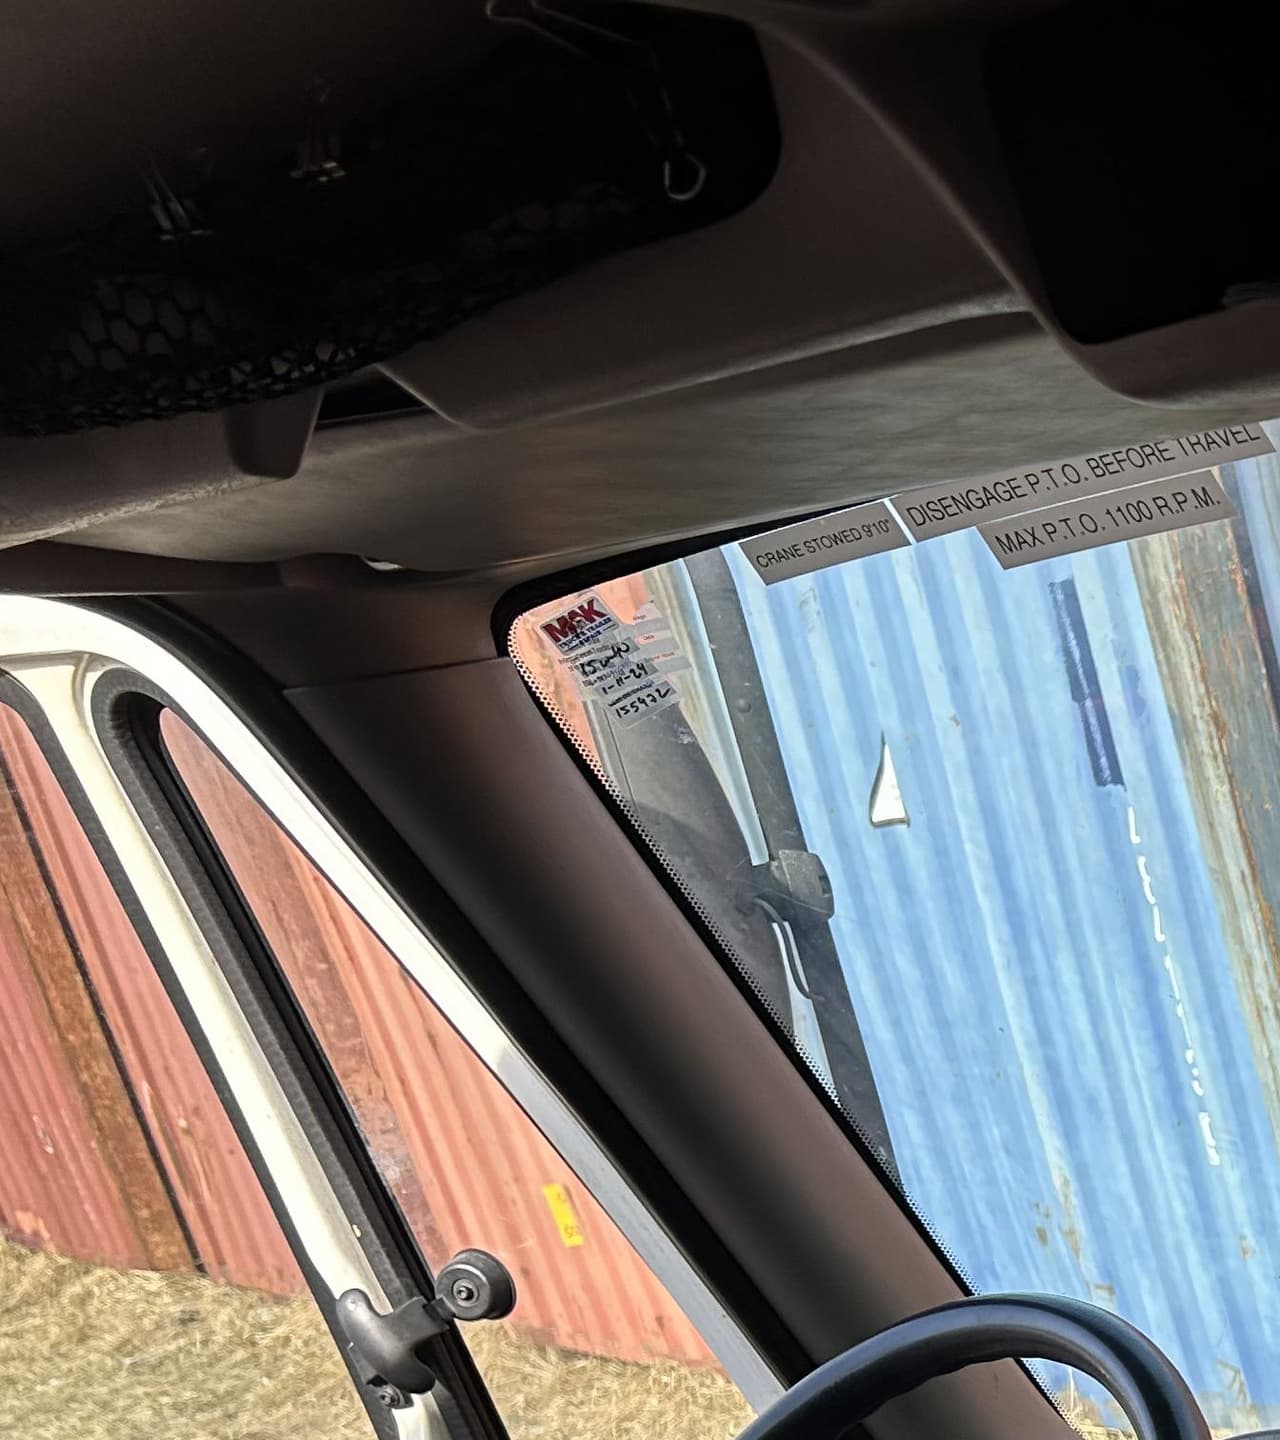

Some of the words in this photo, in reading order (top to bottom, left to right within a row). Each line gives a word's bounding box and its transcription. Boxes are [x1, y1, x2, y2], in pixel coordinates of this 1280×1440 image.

[906, 477, 1027, 527] DISENGAGE
[1025, 463, 1089, 494] P.T.O.
[1086, 440, 1175, 478] BEFORE
[756, 543, 805, 568] CRANE
[803, 527, 862, 554] STOWED
[995, 526, 1044, 555] MAX
[1042, 512, 1105, 543] P.T.O.
[1105, 499, 1153, 527] 1100
[1152, 486, 1221, 516] R.P.M.
